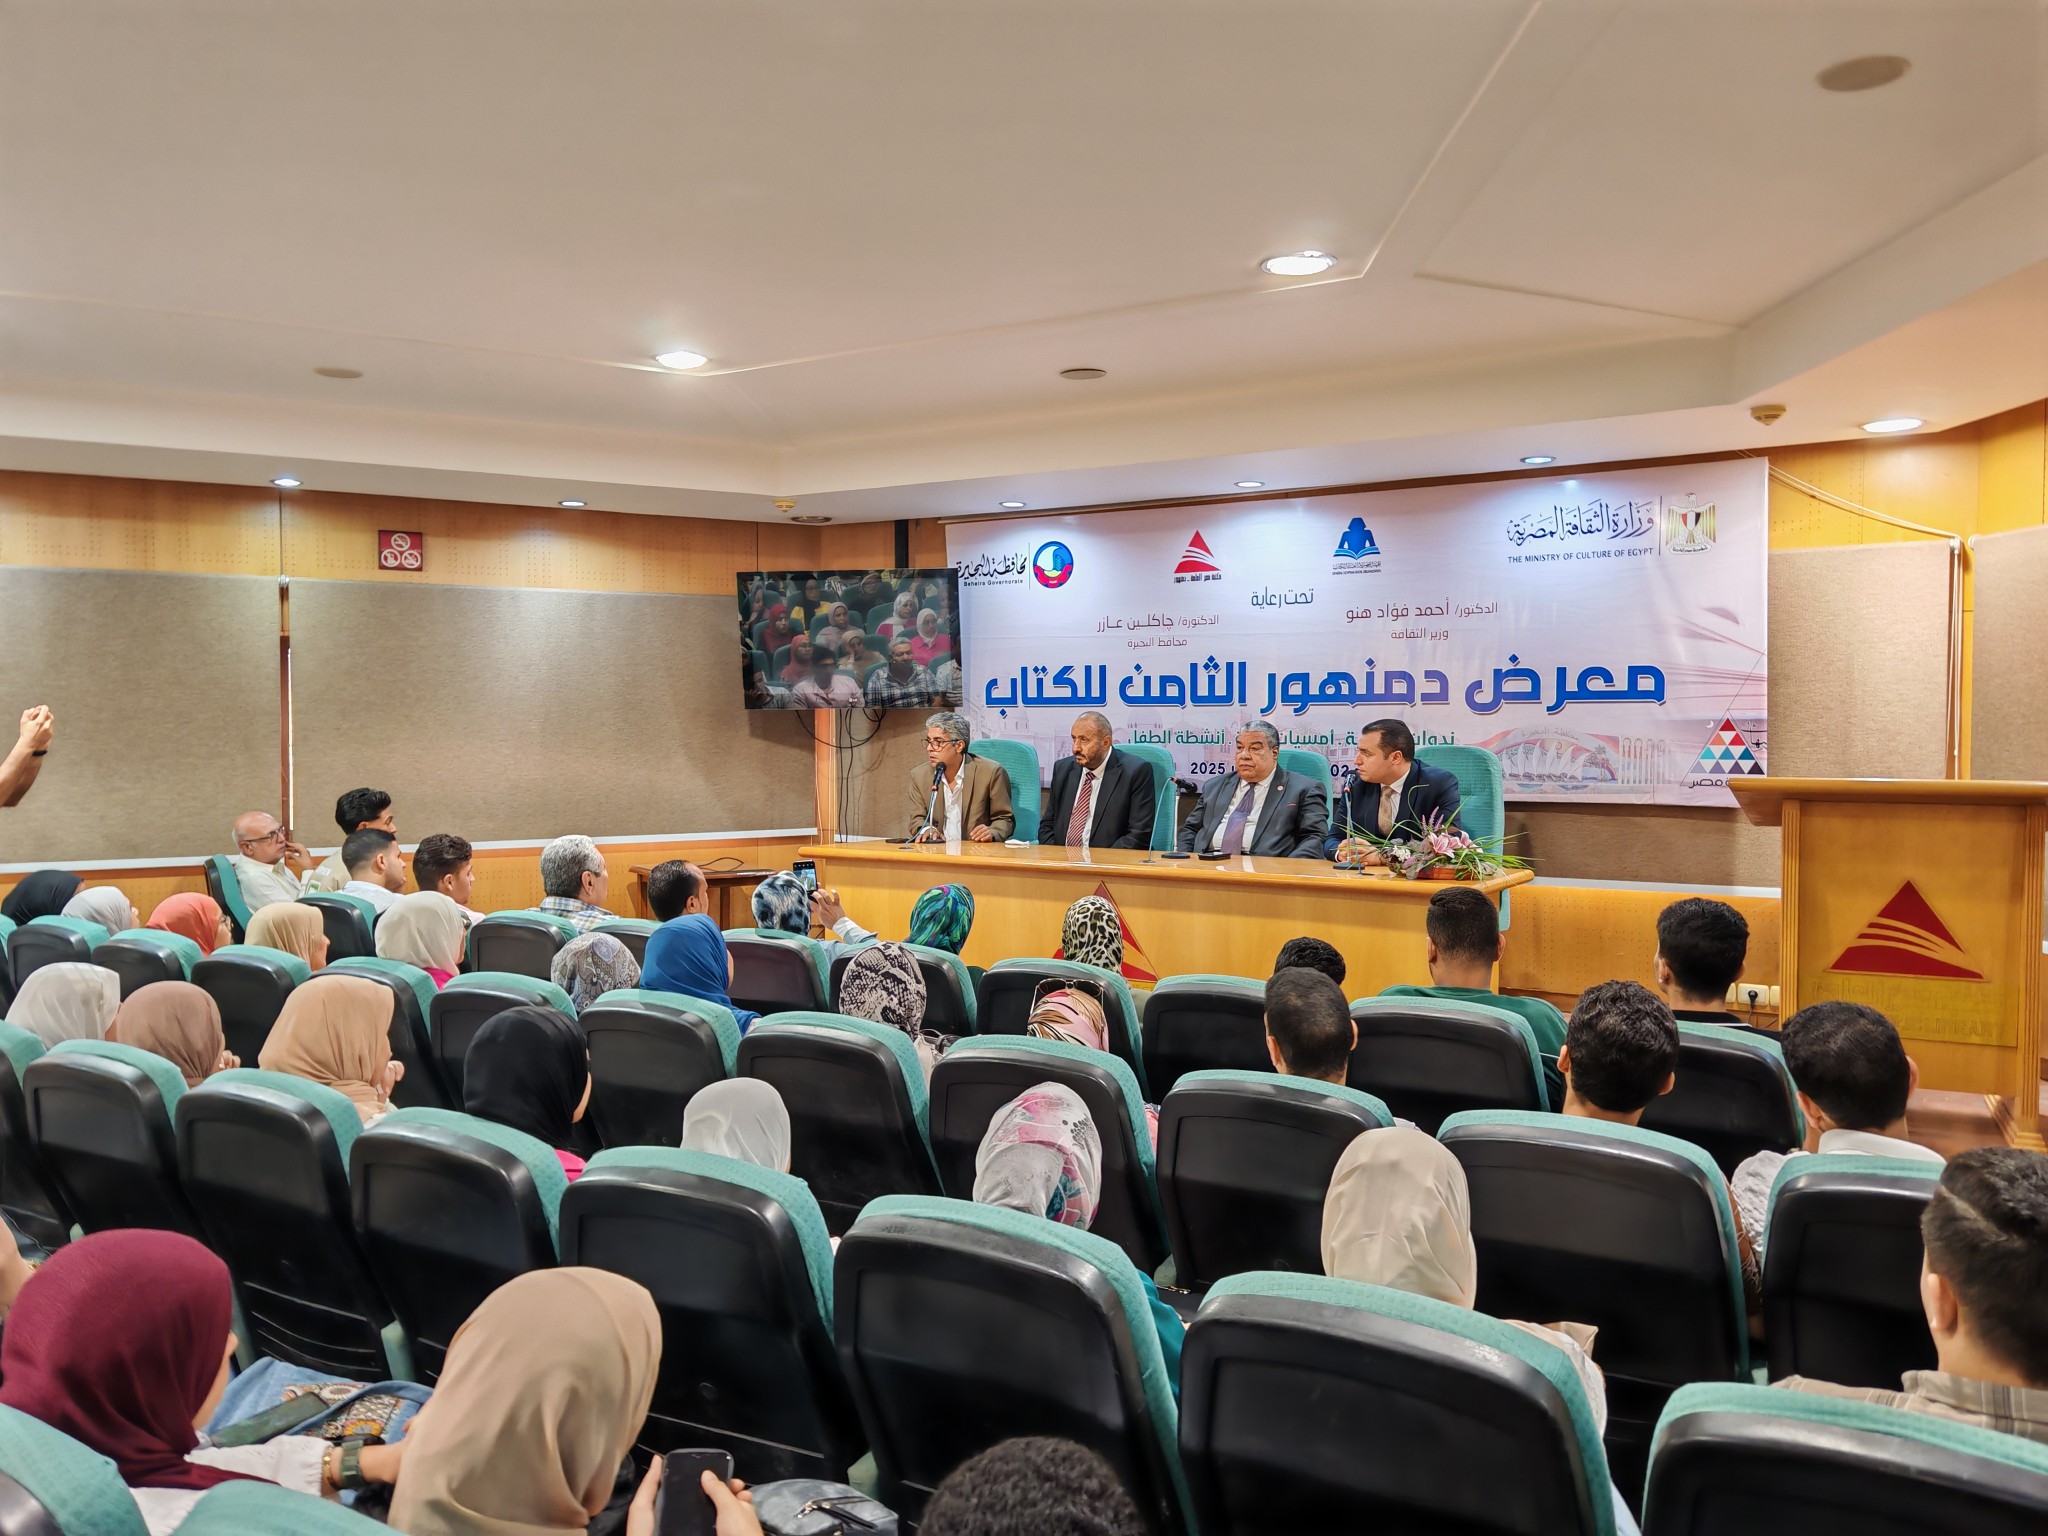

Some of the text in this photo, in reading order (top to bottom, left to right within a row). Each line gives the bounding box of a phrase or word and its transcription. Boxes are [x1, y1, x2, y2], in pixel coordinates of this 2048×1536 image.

[1507, 499, 1654, 546] وزارة الثقافة المصرية
[1525, 553, 1560, 562] MINISTRY
[1563, 552, 1573, 560] OF
[1576, 550, 1611, 560] CULTURE
[1614, 549, 1625, 557] OF
[1628, 547, 1653, 556] EGYPT
[1251, 586, 1314, 609] تحت رعاية
[1346, 606, 1372, 623] هنو
[1376, 602, 1409, 622] فؤاد
[1414, 597, 1450, 616] أحمد
[1391, 627, 1449, 641] وزير الثقافة
[1127, 636, 1187, 650] محافظ البحيرة
[985, 653, 1667, 717] معرض دمنهور الثامن للكتاب
[1176, 728, 1225, 744] أنشطة
[1190, 762, 1225, 775] 2025
[1688, 778, 1723, 789] مصر
